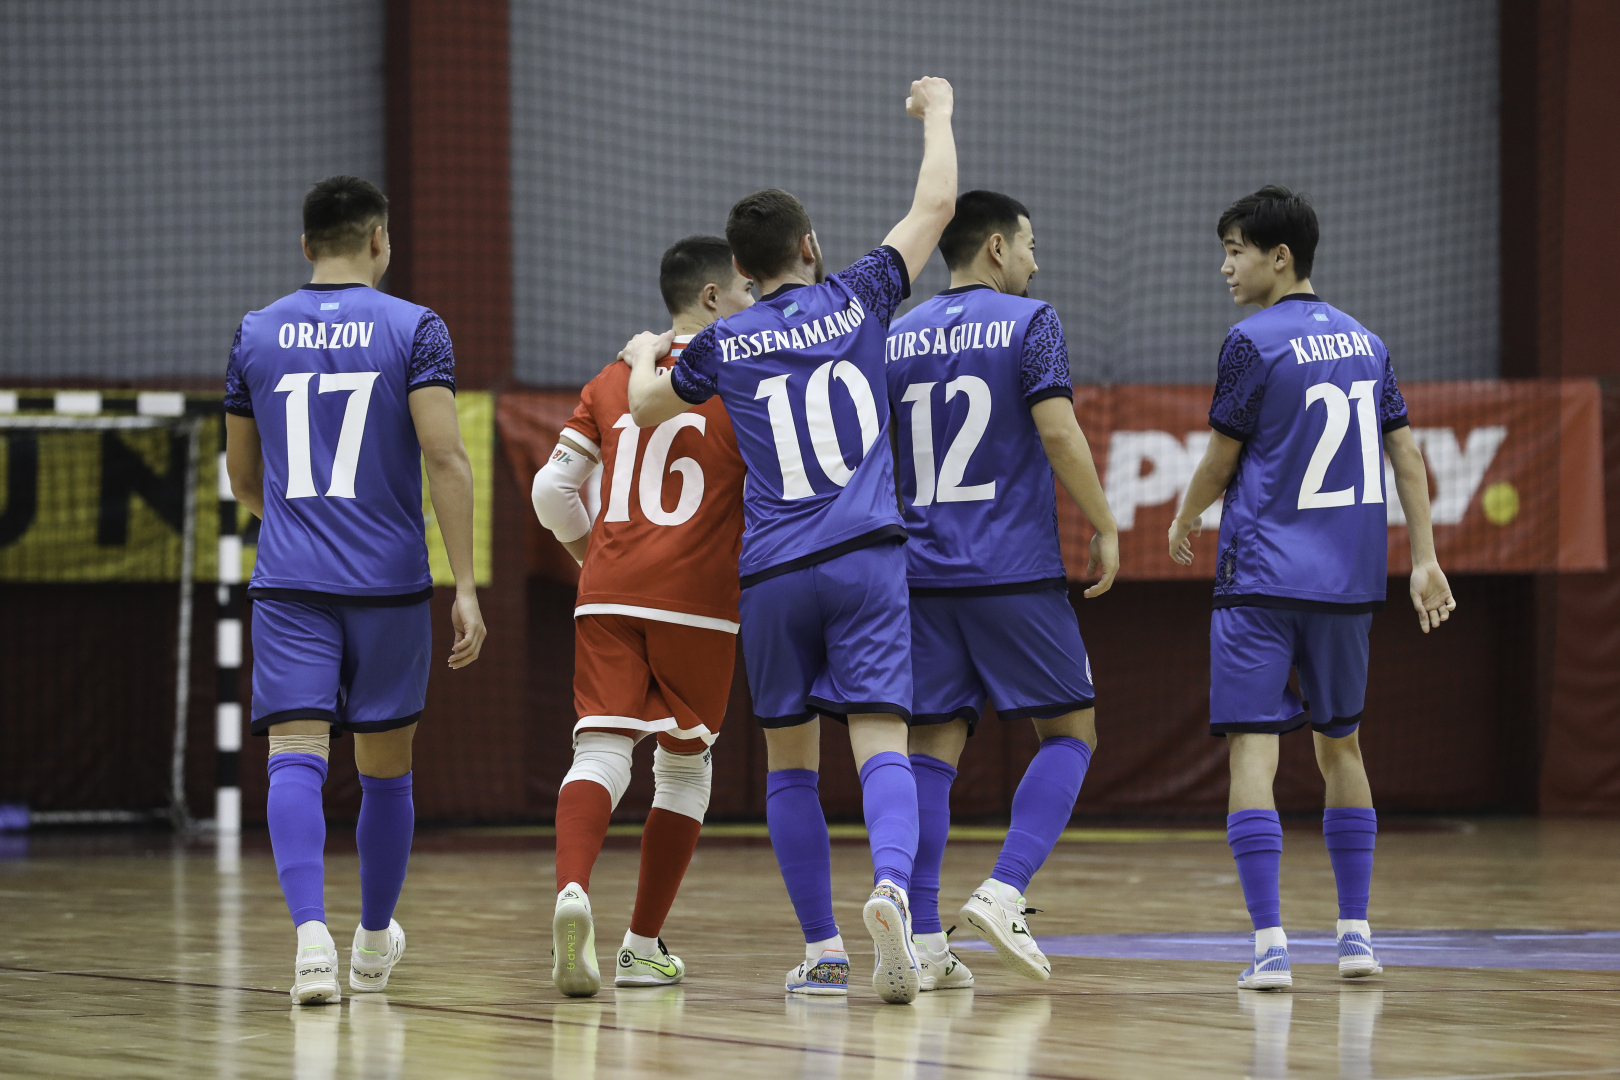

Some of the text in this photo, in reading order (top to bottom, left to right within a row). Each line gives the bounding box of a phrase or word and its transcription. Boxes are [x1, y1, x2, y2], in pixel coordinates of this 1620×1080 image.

[278, 321, 375, 350] ORAZOV
[718, 296, 866, 363] YESSENAMANOV
[273, 371, 381, 500] 17
[603, 412, 707, 527] 16
[754, 360, 880, 501] 10
[900, 374, 996, 507] 12
[1297, 379, 1385, 510] 21
